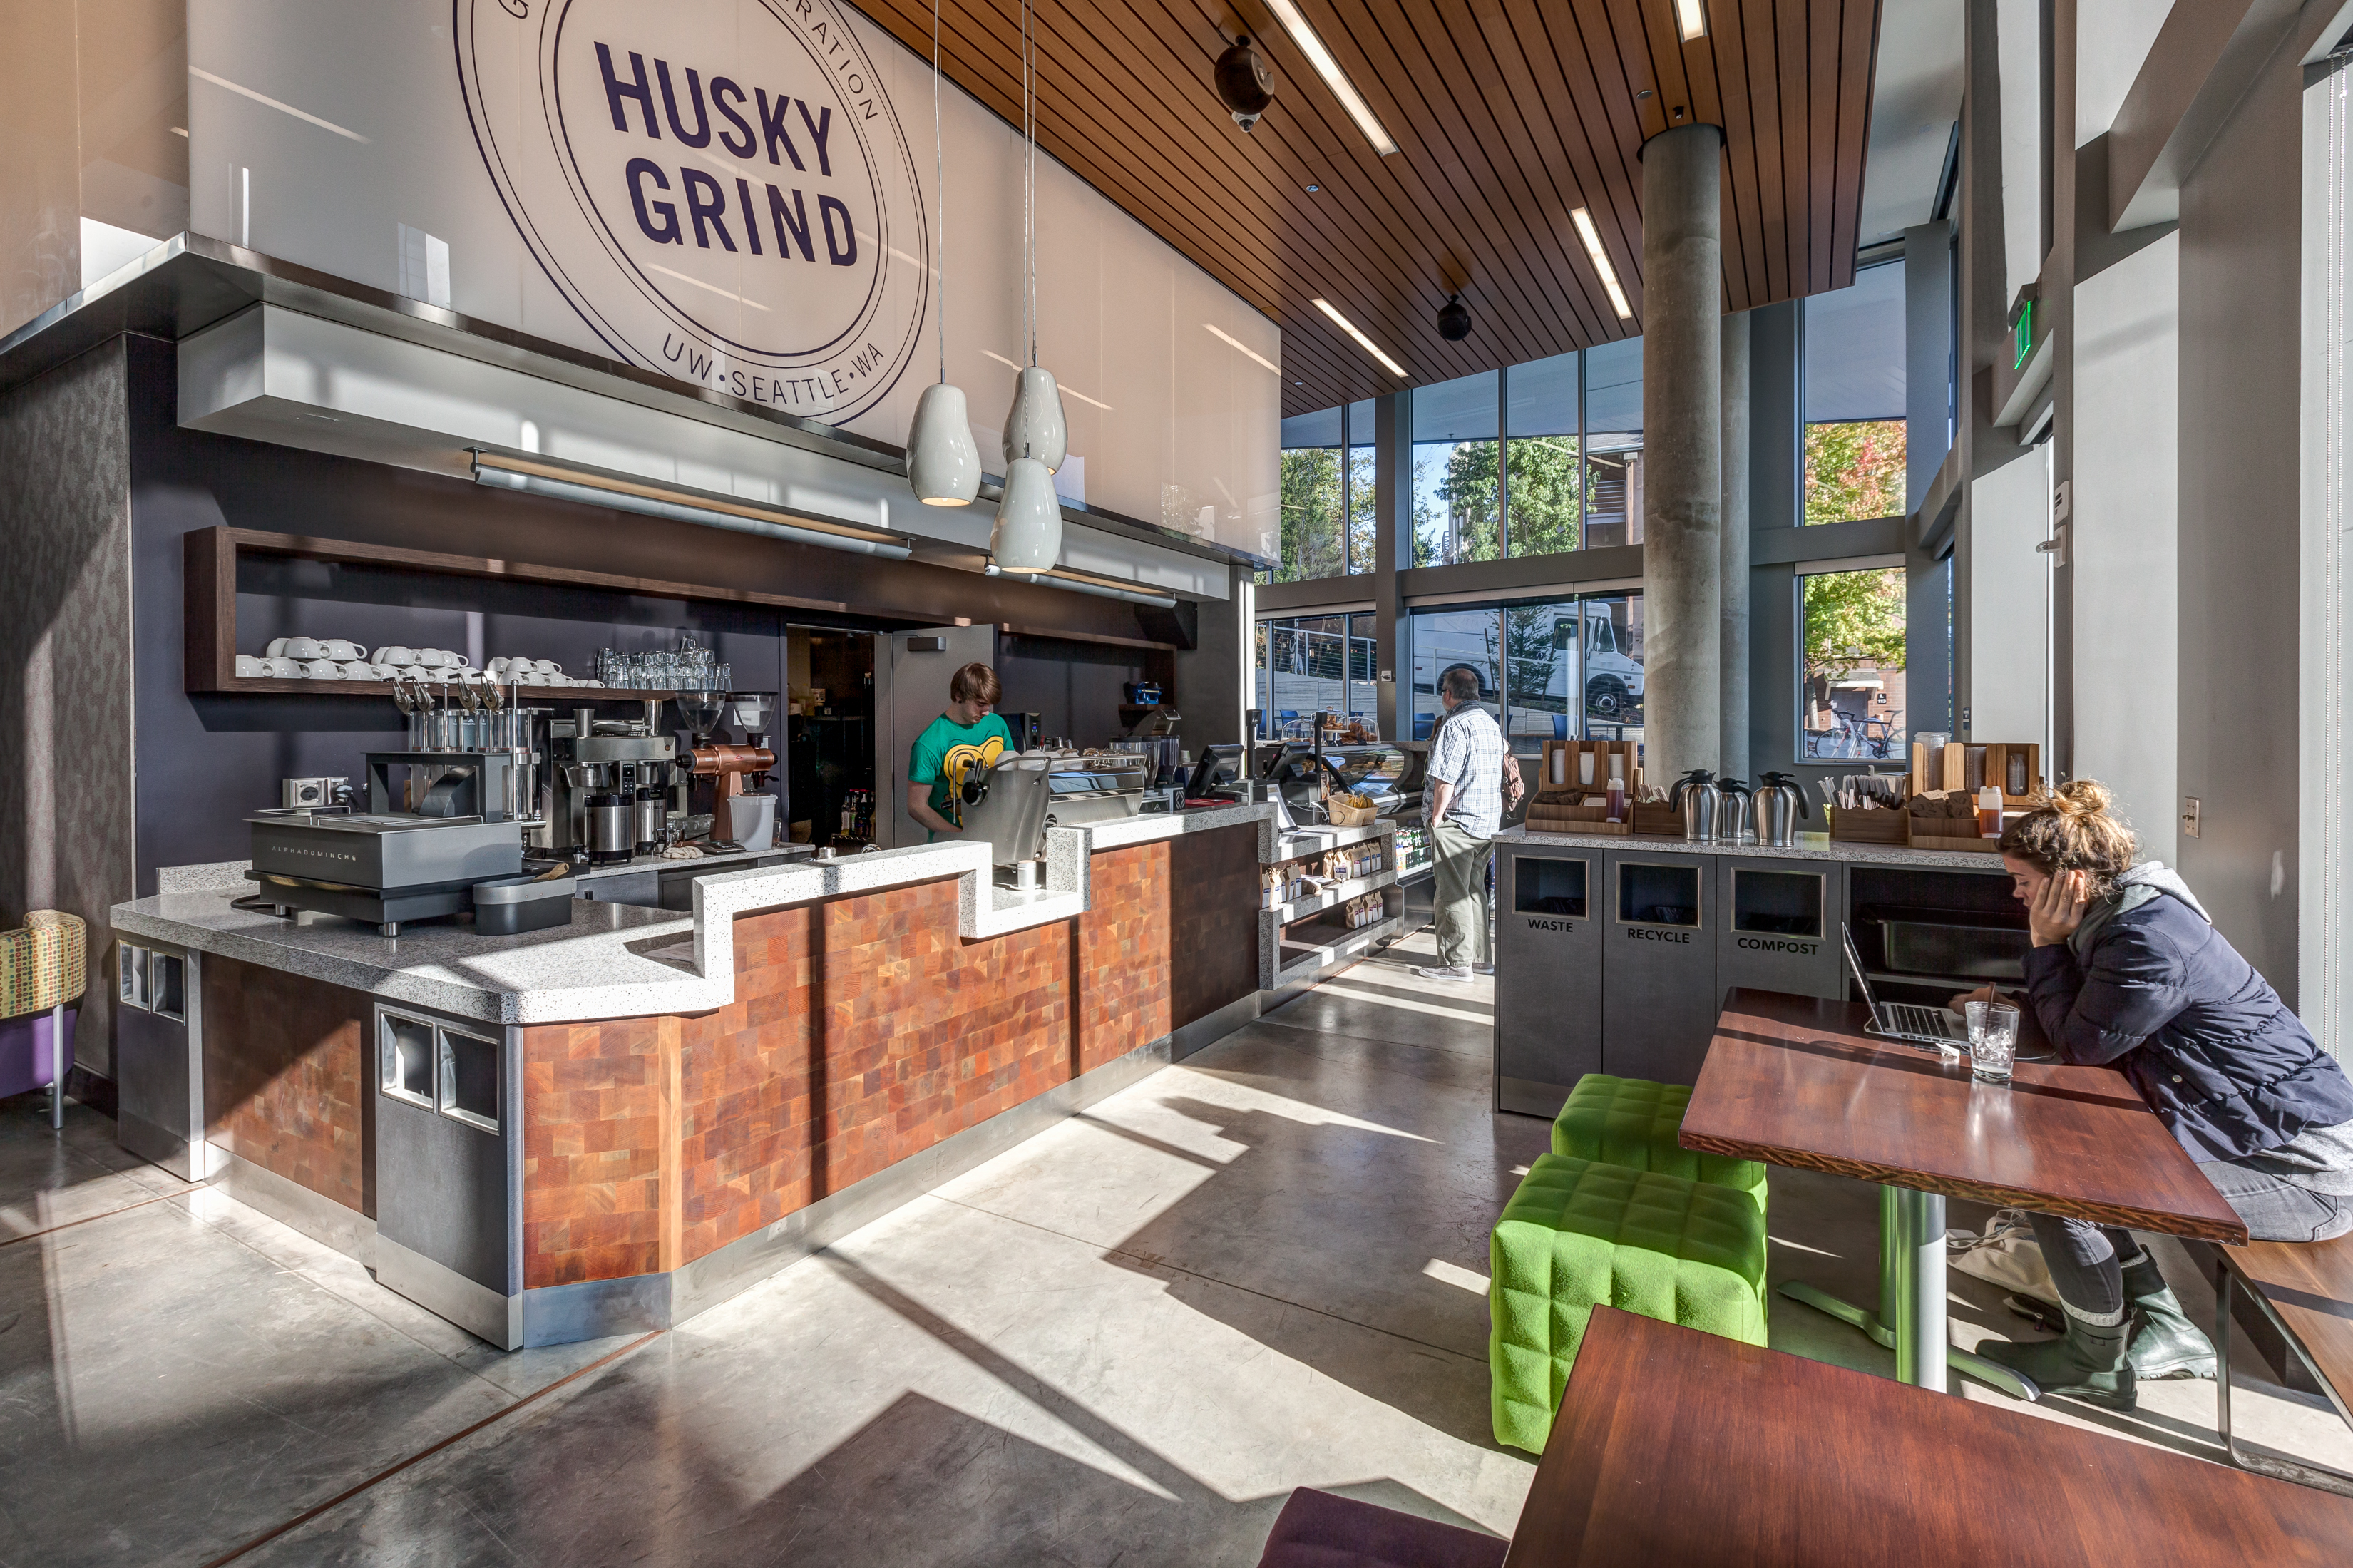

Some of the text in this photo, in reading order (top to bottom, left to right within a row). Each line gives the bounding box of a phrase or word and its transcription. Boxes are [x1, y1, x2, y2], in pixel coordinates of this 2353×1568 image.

[785, 0, 878, 121] RATION
[593, 41, 833, 178] HUSKY
[625, 157, 858, 268] GRIND
[272, 846, 357, 861] ALPHADOMINCHE
[1527, 918, 1574, 933] WASTE
[1627, 928, 1690, 944] RECYCLE
[1737, 937, 1819, 955] COMPOST
